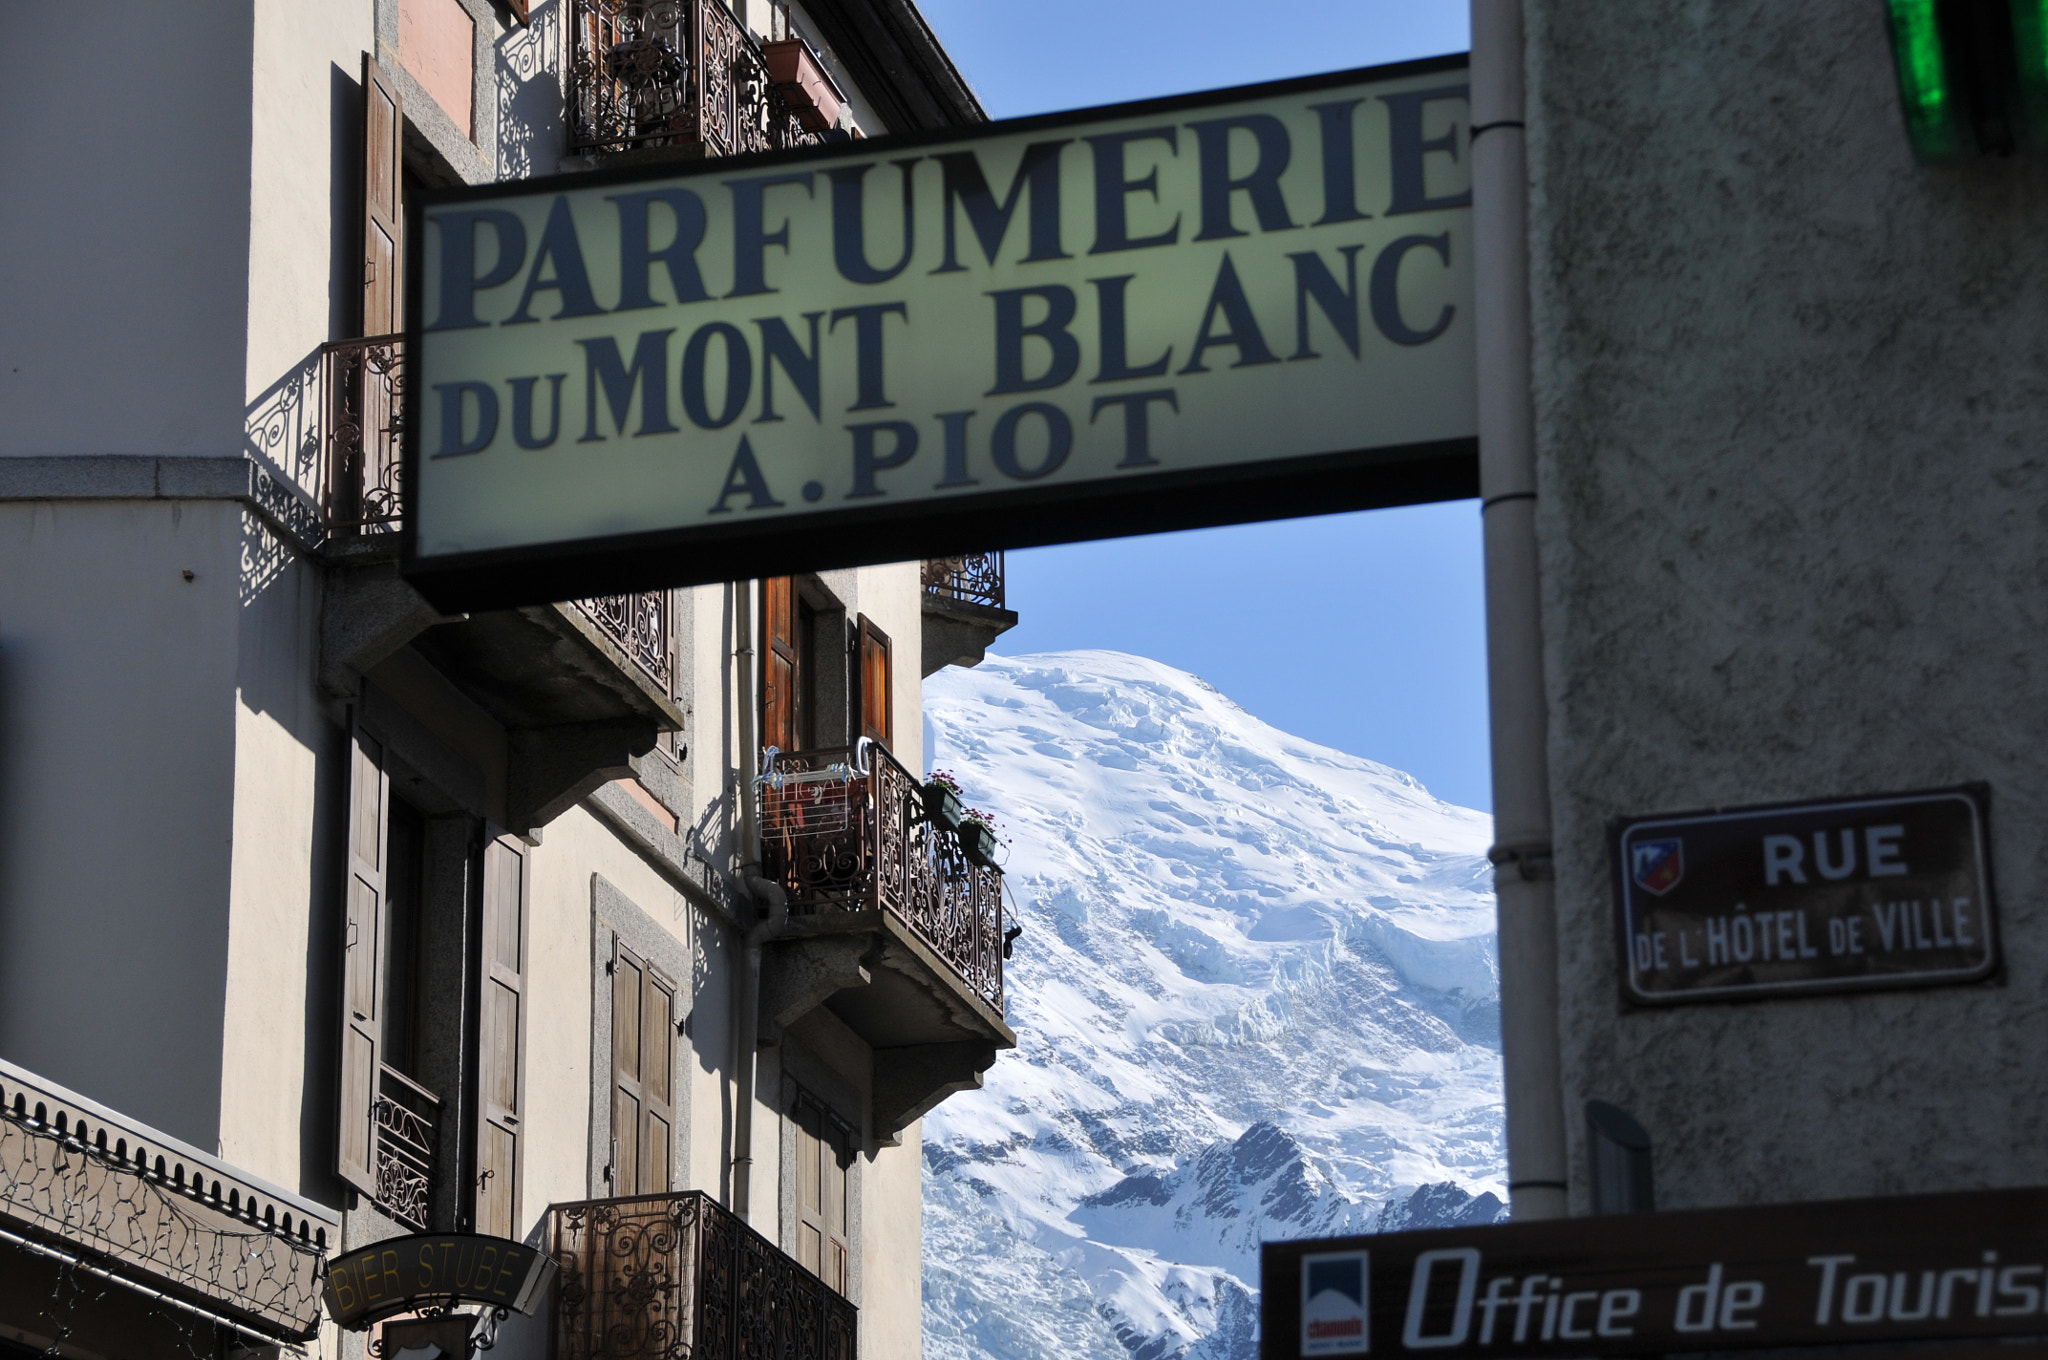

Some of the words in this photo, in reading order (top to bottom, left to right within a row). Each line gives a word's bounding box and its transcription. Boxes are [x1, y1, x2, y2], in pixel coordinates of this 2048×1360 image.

[424, 83, 1473, 333] PARFUMERIE
[430, 374, 567, 460] DU
[574, 302, 908, 444] MONT
[982, 232, 1456, 398] BLANC
[1763, 825, 1907, 886] RUE
[1636, 932, 1669, 972] DE
[1829, 916, 1863, 955] DE
[1873, 897, 1975, 951] VILLE
[331, 1250, 400, 1312] BIER
[418, 1242, 520, 1296] STUBE
[1402, 1247, 1640, 1350] Office
[1674, 1262, 1764, 1333] de
[1806, 1250, 2048, 1326] Touris
